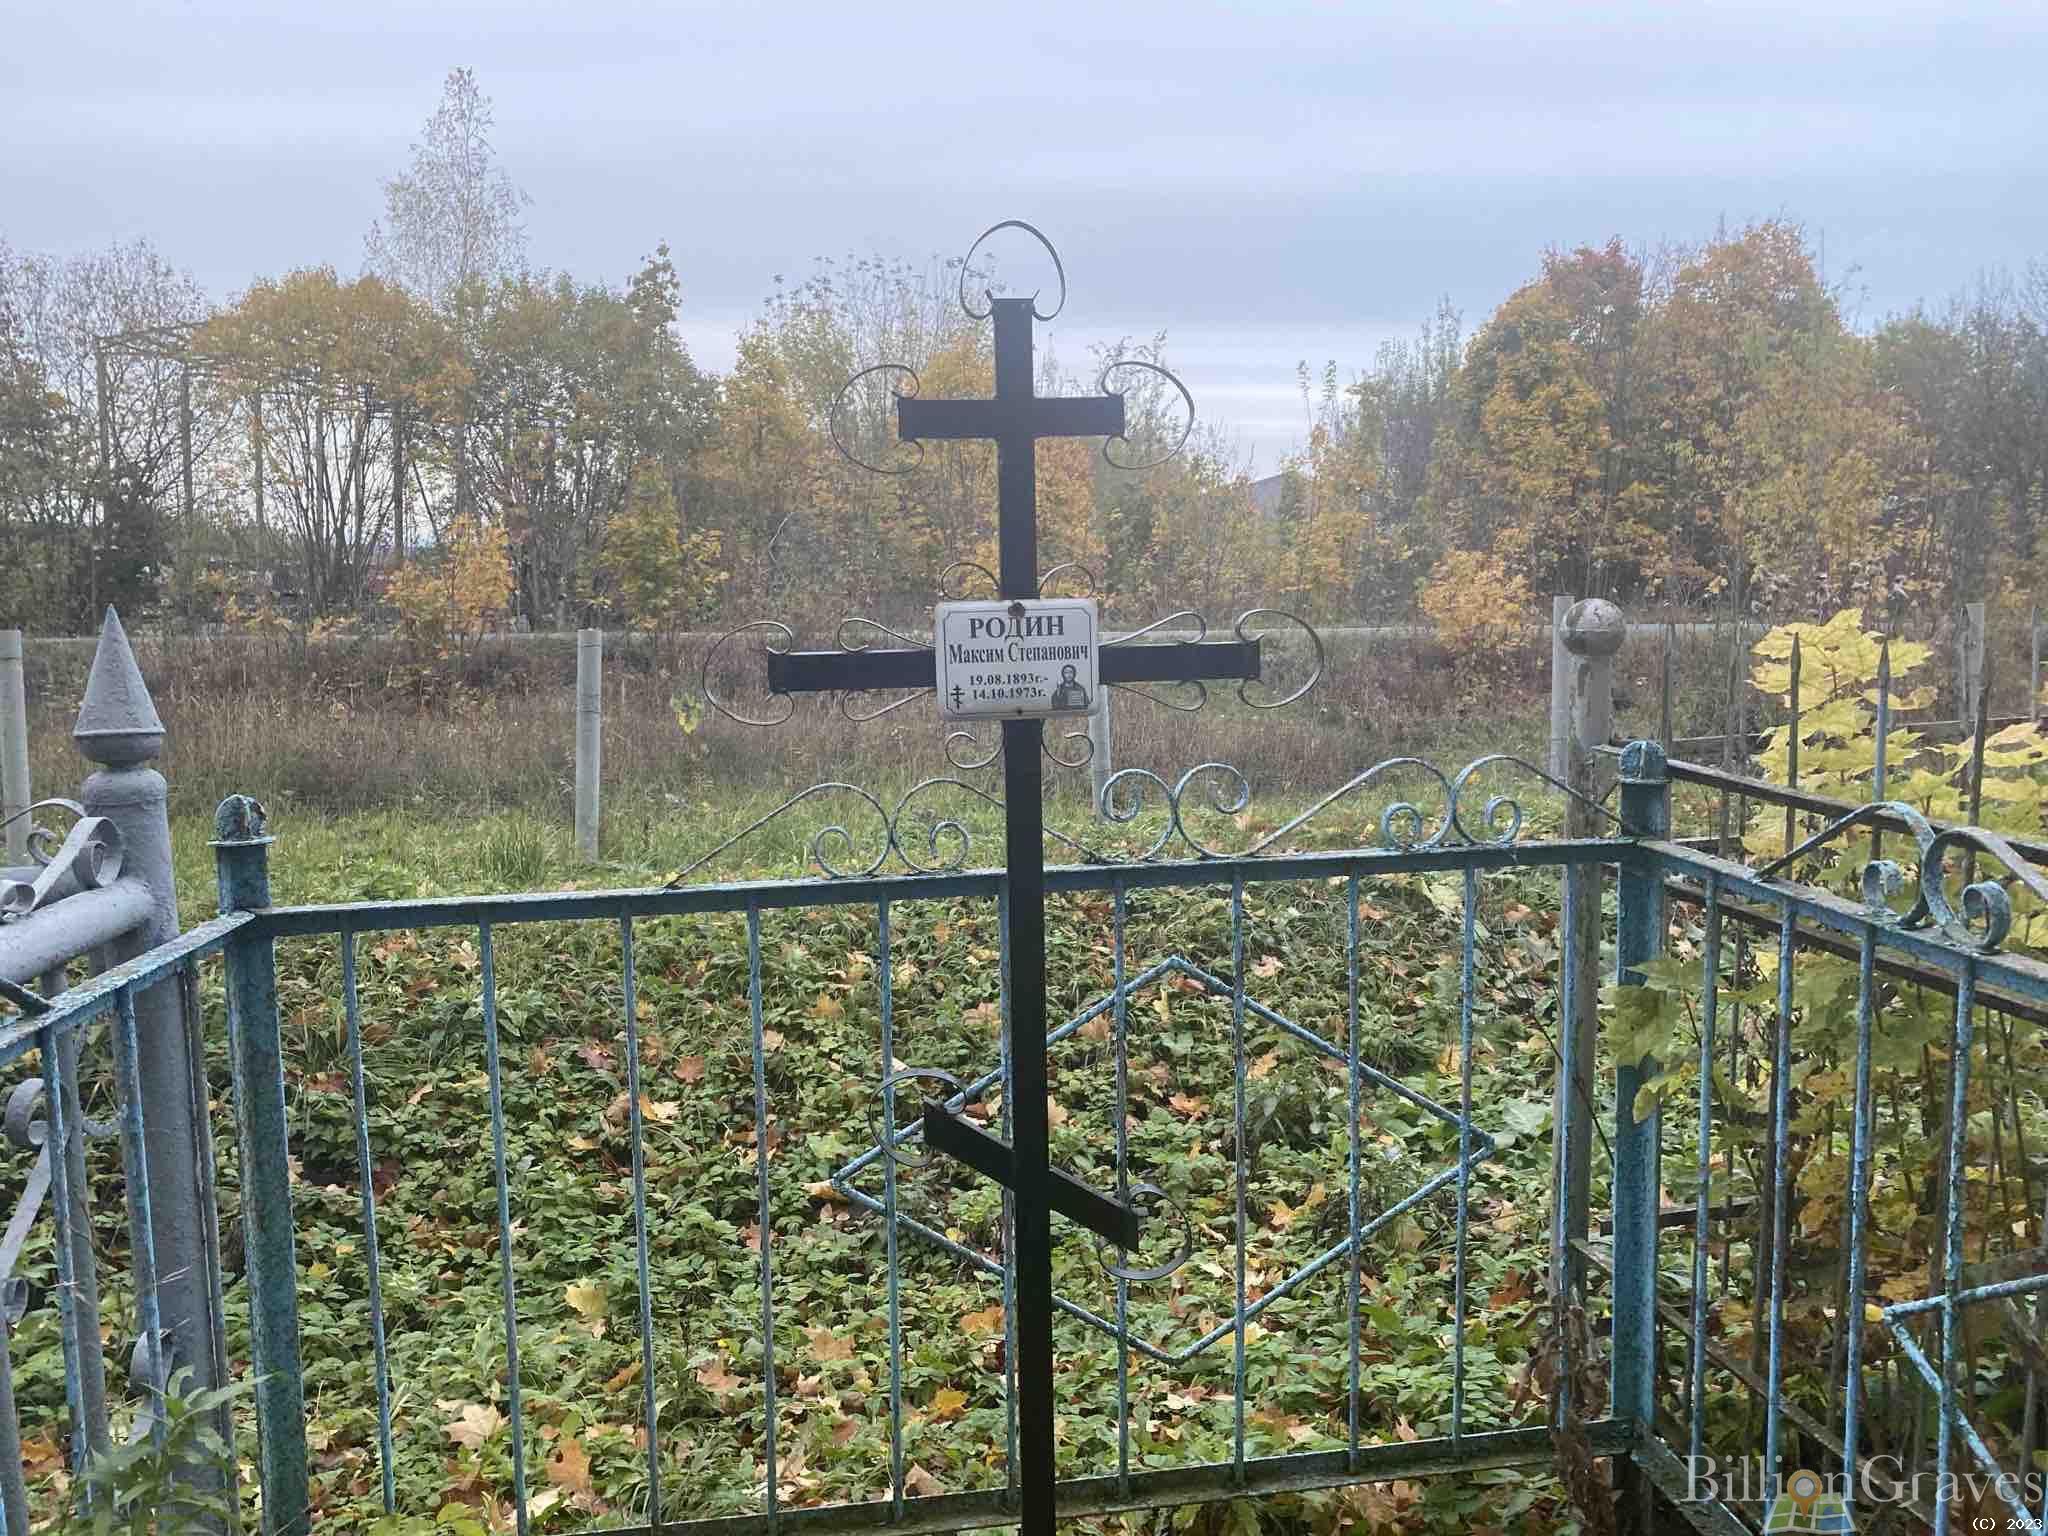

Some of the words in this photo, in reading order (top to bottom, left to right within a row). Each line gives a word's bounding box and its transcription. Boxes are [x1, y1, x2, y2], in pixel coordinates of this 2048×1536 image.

[968, 614, 1065, 642] РОДИН
[949, 643, 1005, 665] Максим
[1008, 641, 1089, 662] Степанович
[972, 686, 1047, 701] 14.10.1973г.
